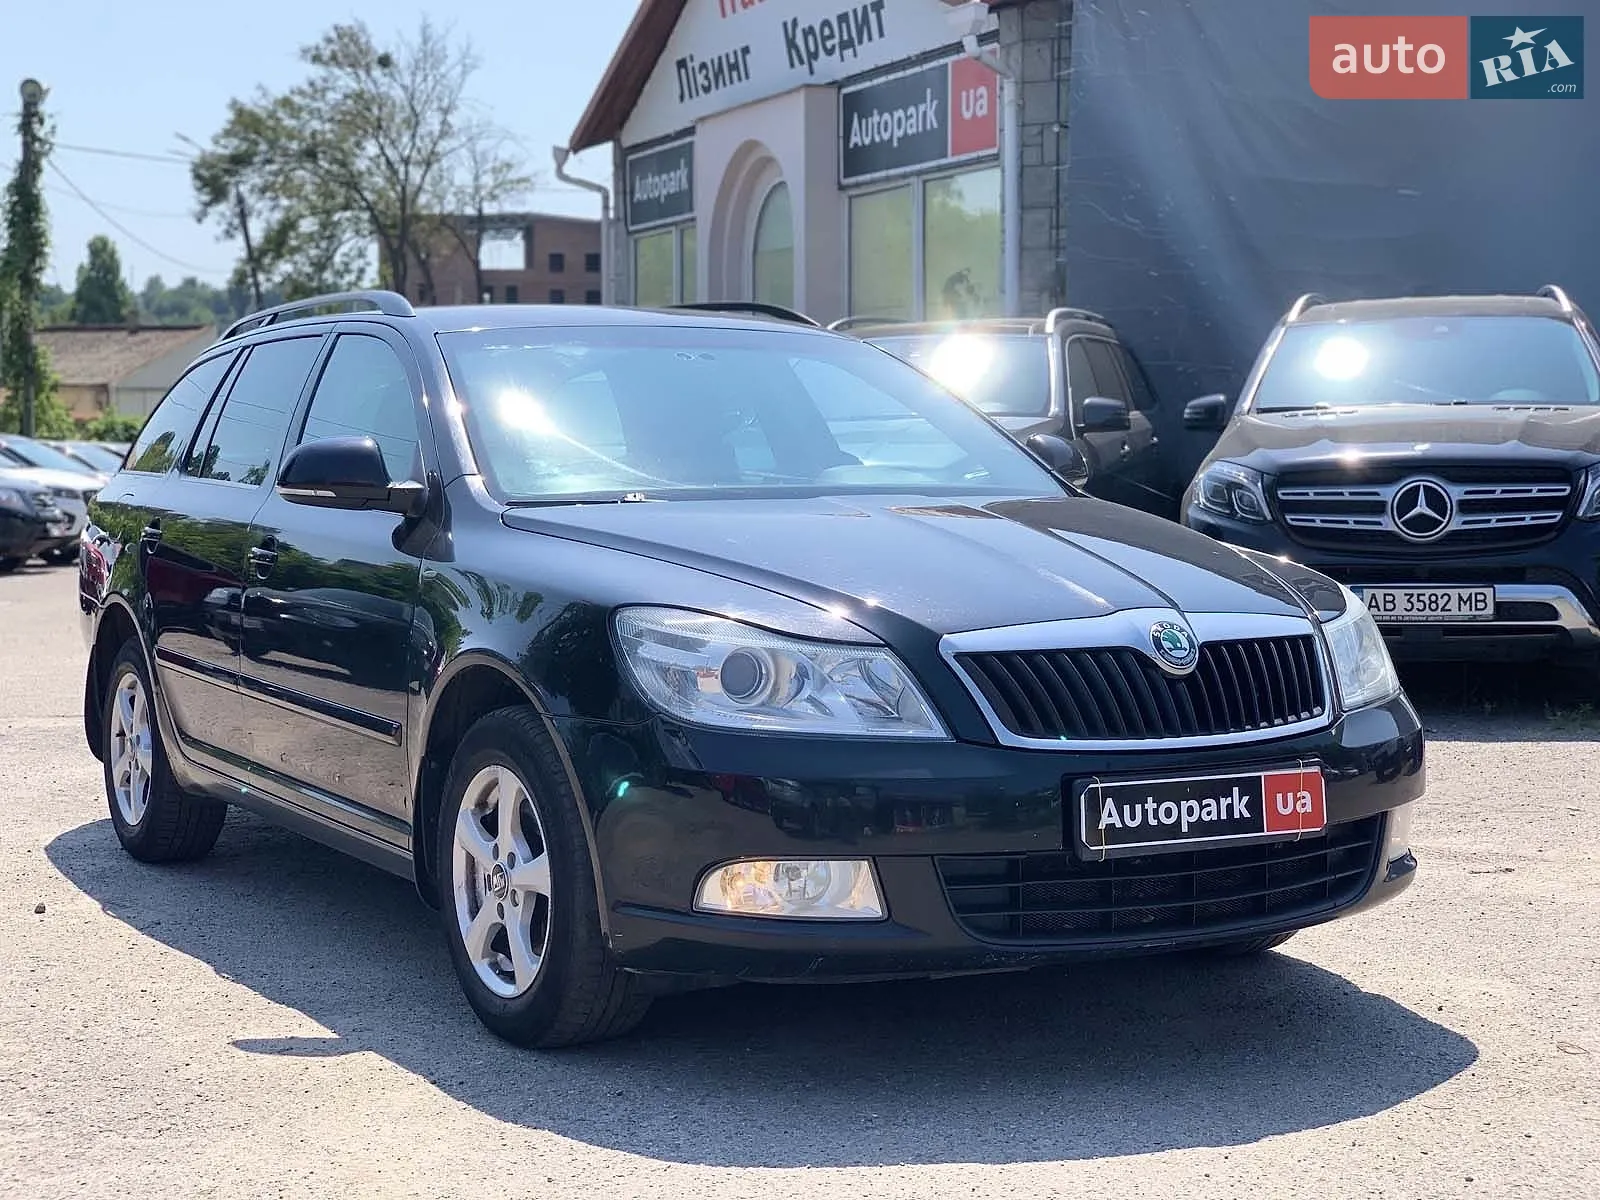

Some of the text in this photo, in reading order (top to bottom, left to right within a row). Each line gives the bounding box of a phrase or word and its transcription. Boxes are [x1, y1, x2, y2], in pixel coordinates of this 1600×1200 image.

[676, 0, 886, 103] Лізинг Кредит
[849, 85, 989, 149] Autopark ua
[633, 158, 689, 204] Autopark
[1367, 591, 1488, 613] AB 3582 MB
[1098, 786, 1313, 833] Autopark ua
